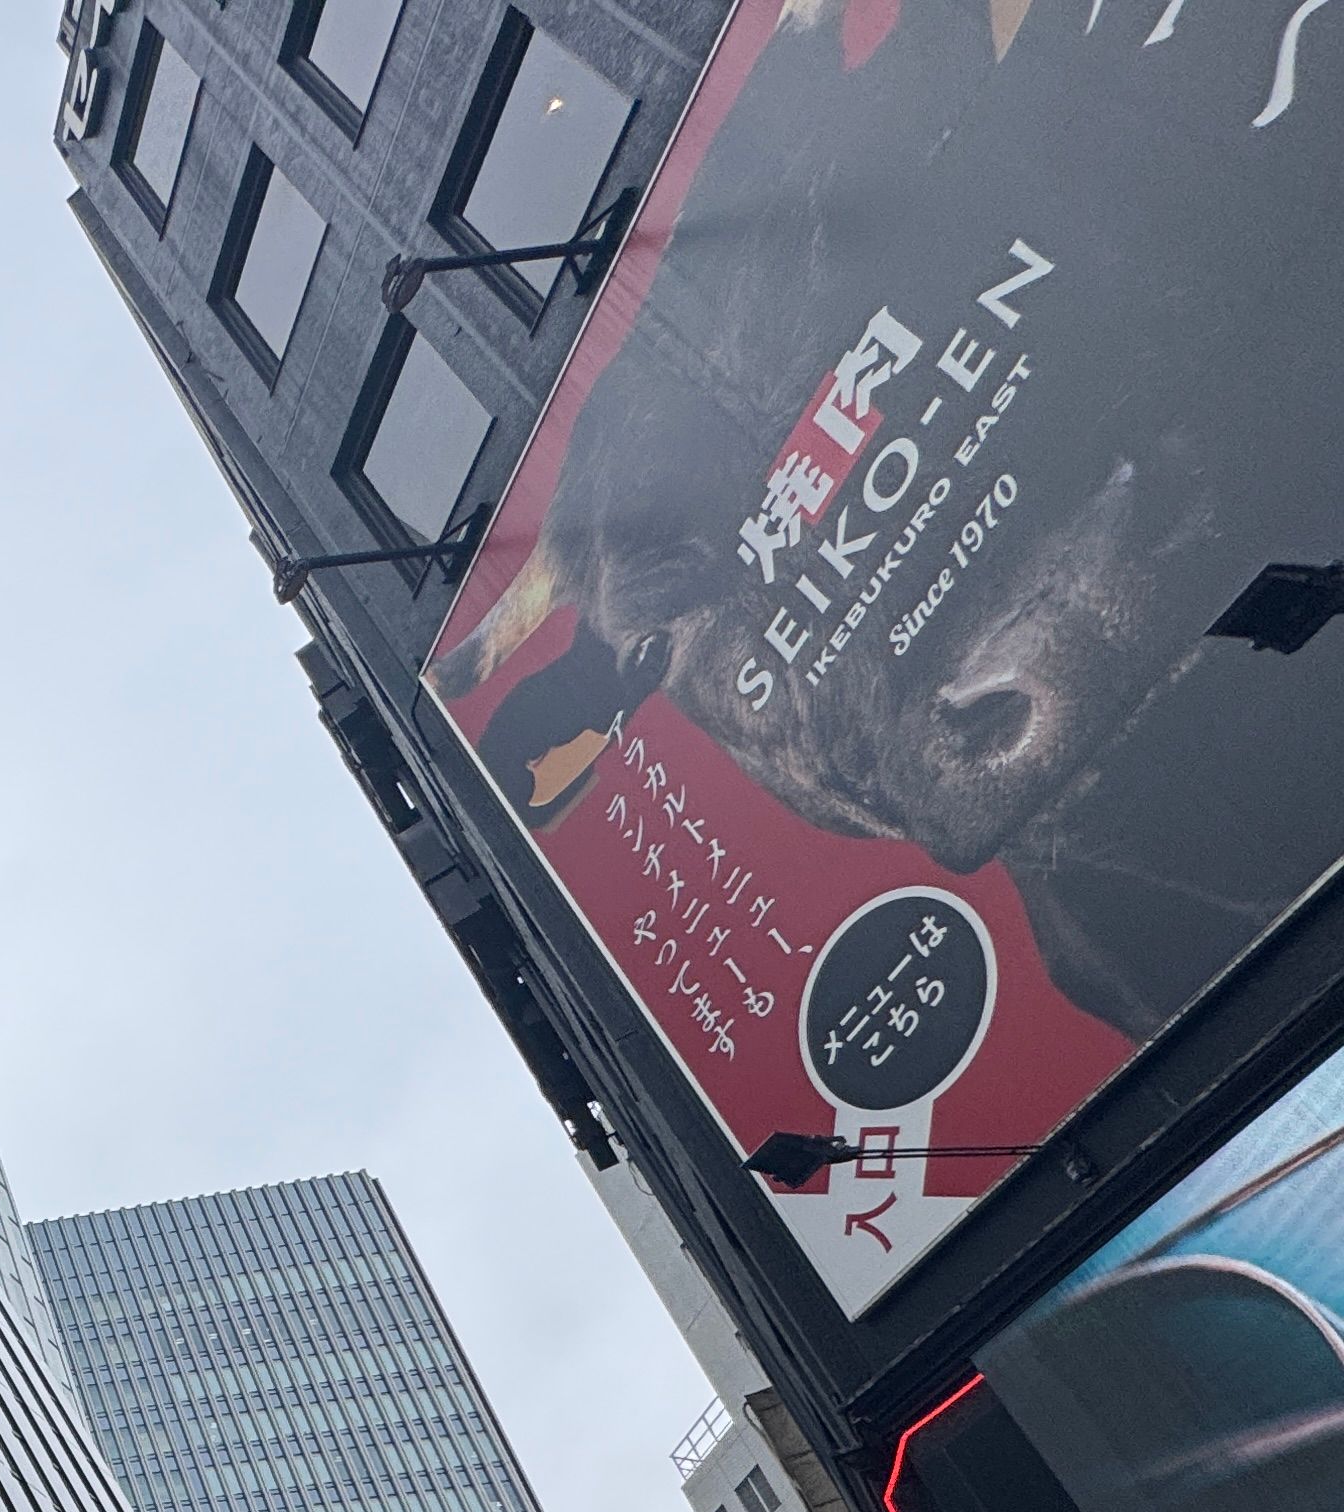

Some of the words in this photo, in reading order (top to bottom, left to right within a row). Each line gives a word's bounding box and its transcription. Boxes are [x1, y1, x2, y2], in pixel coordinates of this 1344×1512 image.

[736, 305, 924, 587] 焼肉
[736, 238, 1055, 712] SEIKO-EN
[805, 477, 953, 688] IKEBUKURO
[953, 353, 1036, 468] EAST
[891, 564, 959, 658] Since
[949, 473, 1020, 573] 1970
[606, 796, 776, 1019] ランチメニューも
[632, 913, 738, 1061] やってます
[822, 914, 949, 1066] メニューは
[869, 976, 945, 1068] こちら
[843, 1126, 902, 1253] 入口
